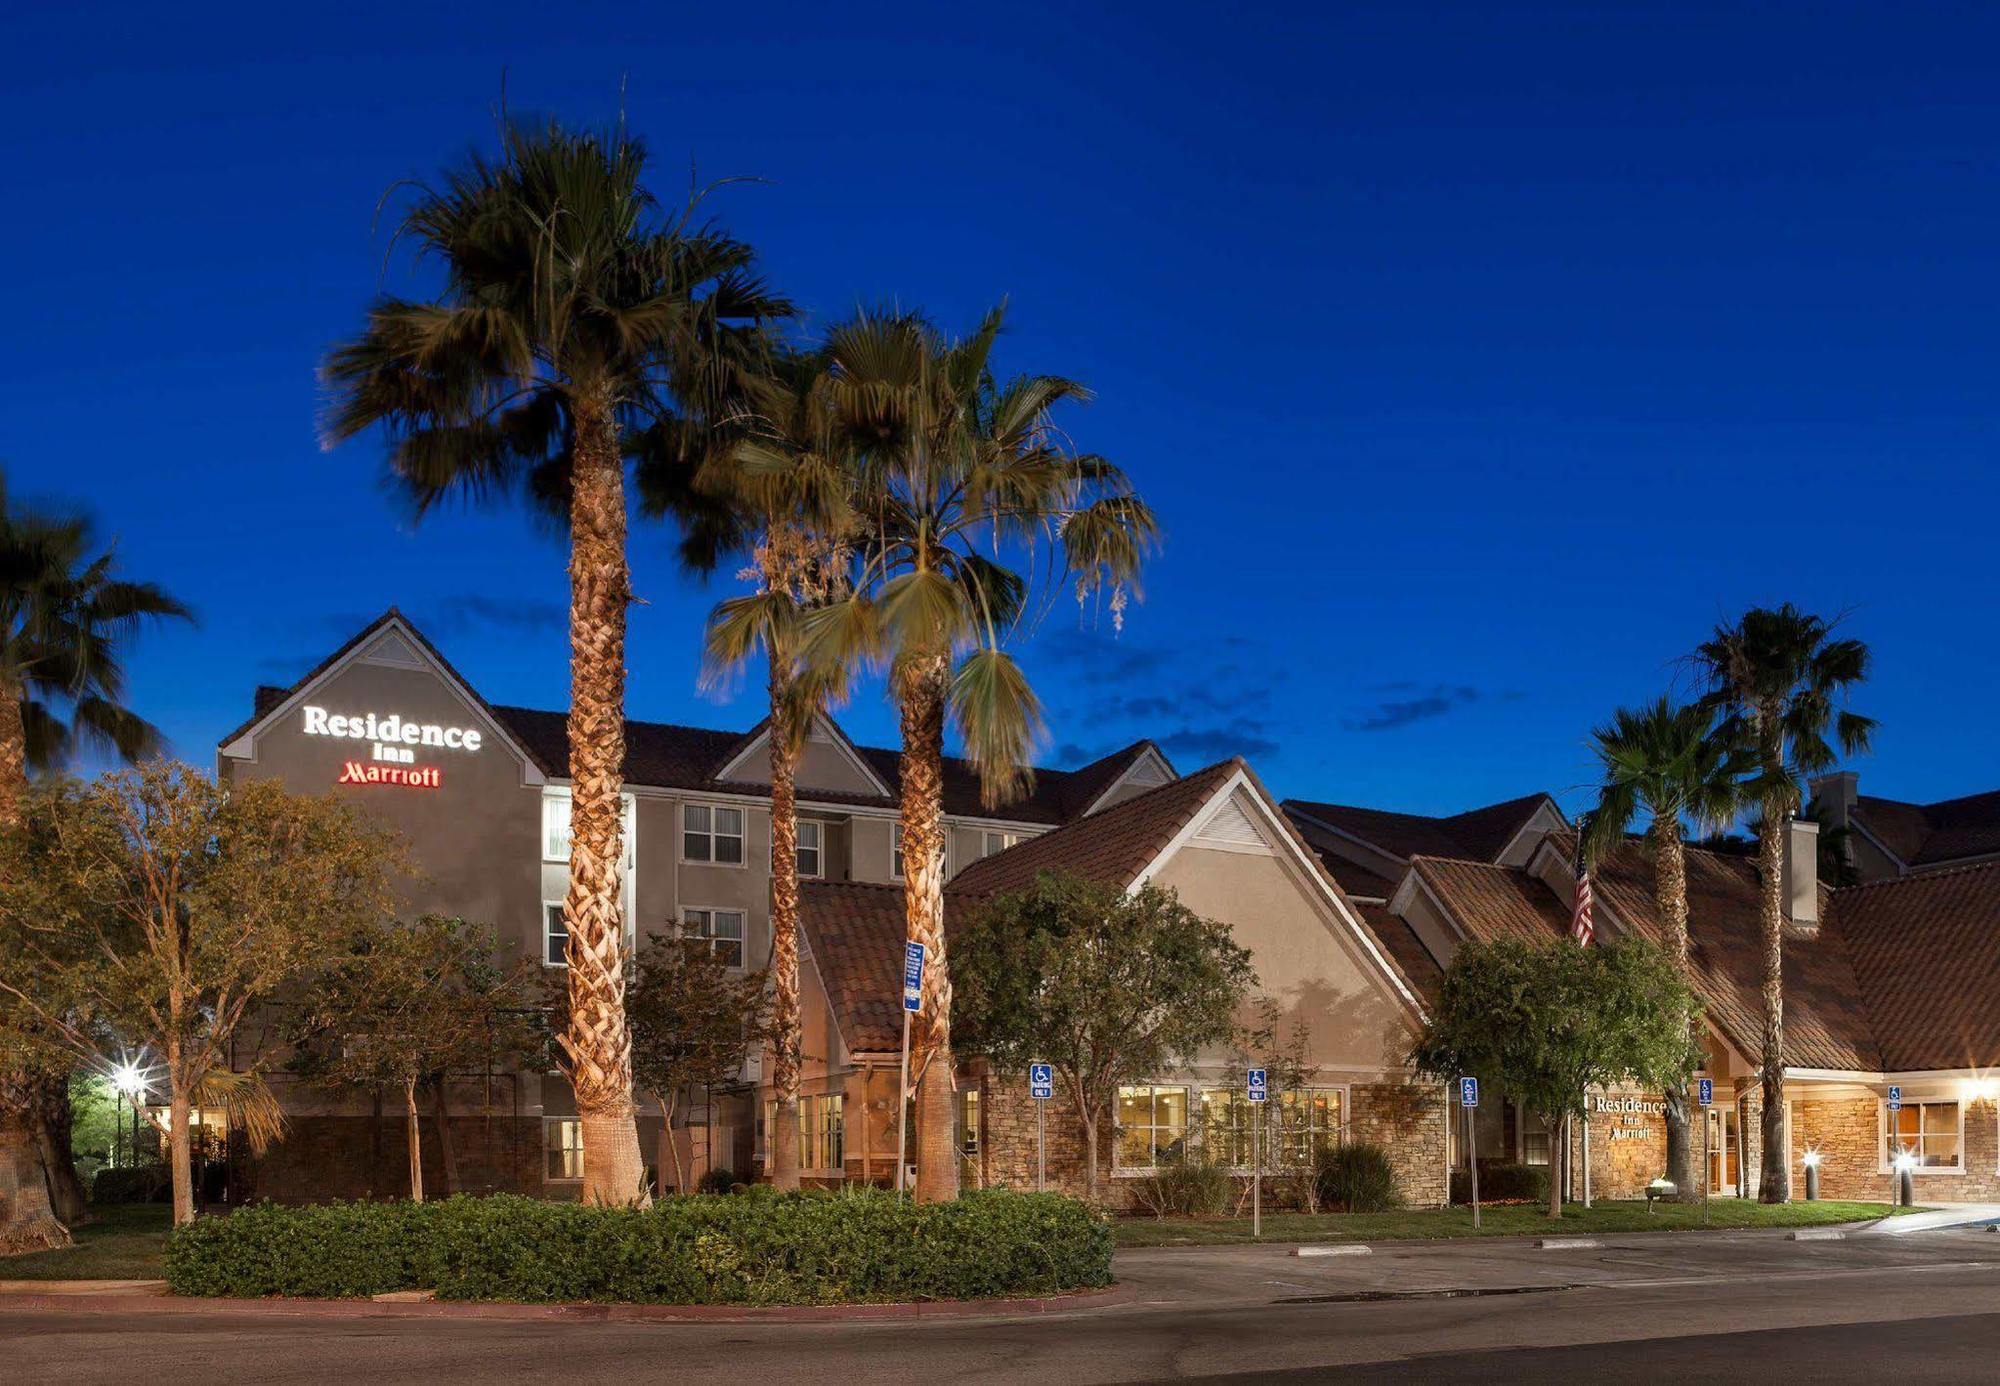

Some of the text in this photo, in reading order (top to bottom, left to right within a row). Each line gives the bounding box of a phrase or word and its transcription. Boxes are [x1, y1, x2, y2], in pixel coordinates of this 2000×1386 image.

[303, 706, 482, 750] Residence
[372, 743, 415, 763] Inn
[339, 761, 441, 788] Marriott
[1596, 1096, 1667, 1113] Residence
[1623, 1114, 1640, 1125] Inn
[1611, 1127, 1650, 1140] Marriott
